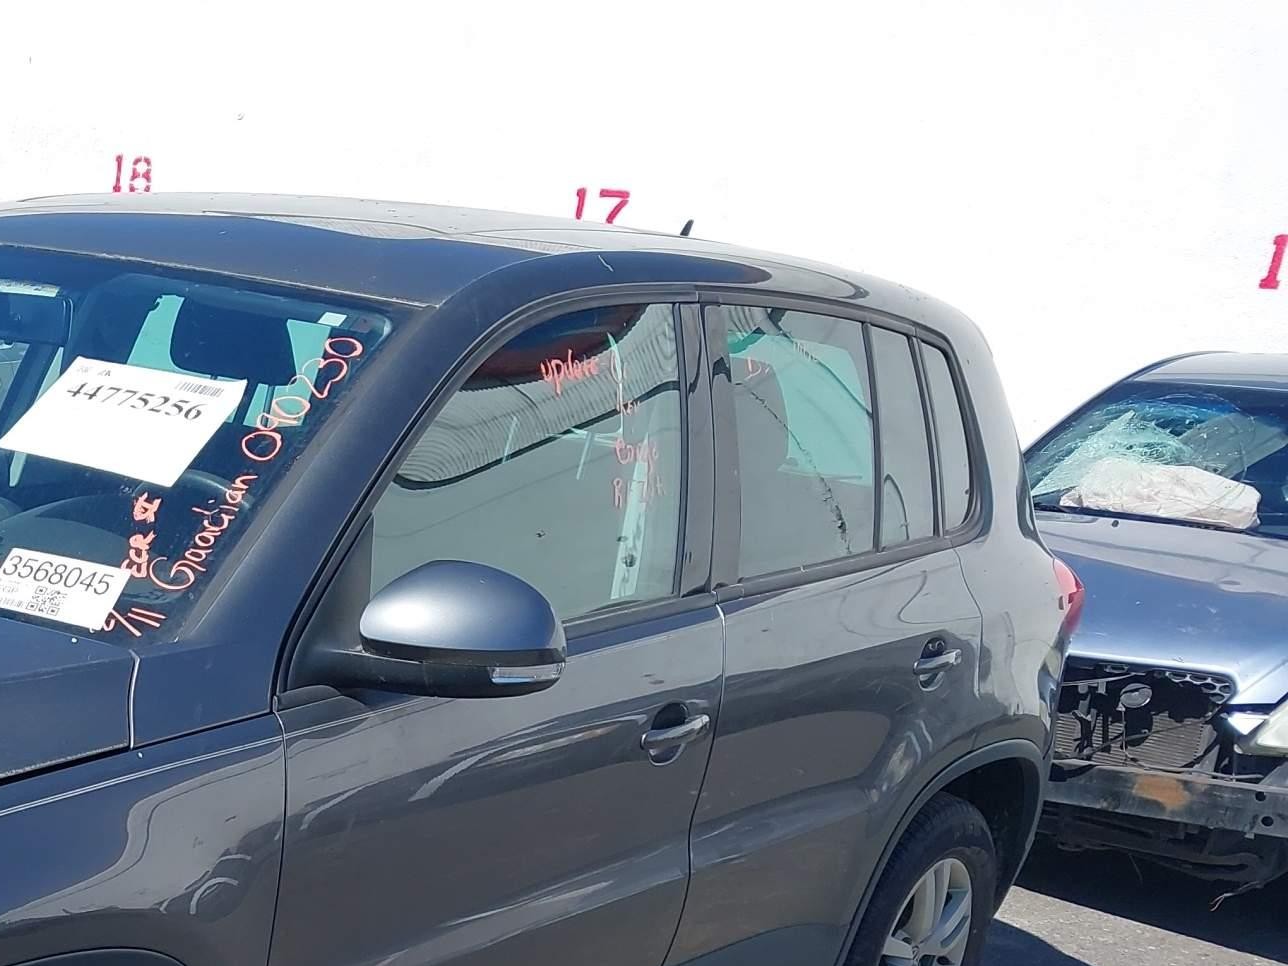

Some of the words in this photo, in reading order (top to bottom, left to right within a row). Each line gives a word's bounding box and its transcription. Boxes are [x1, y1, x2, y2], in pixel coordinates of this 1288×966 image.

[113, 155, 152, 193] 18
[575, 187, 630, 224] 17
[66, 382, 210, 421] 44775256
[2, 554, 115, 596] 3568045
